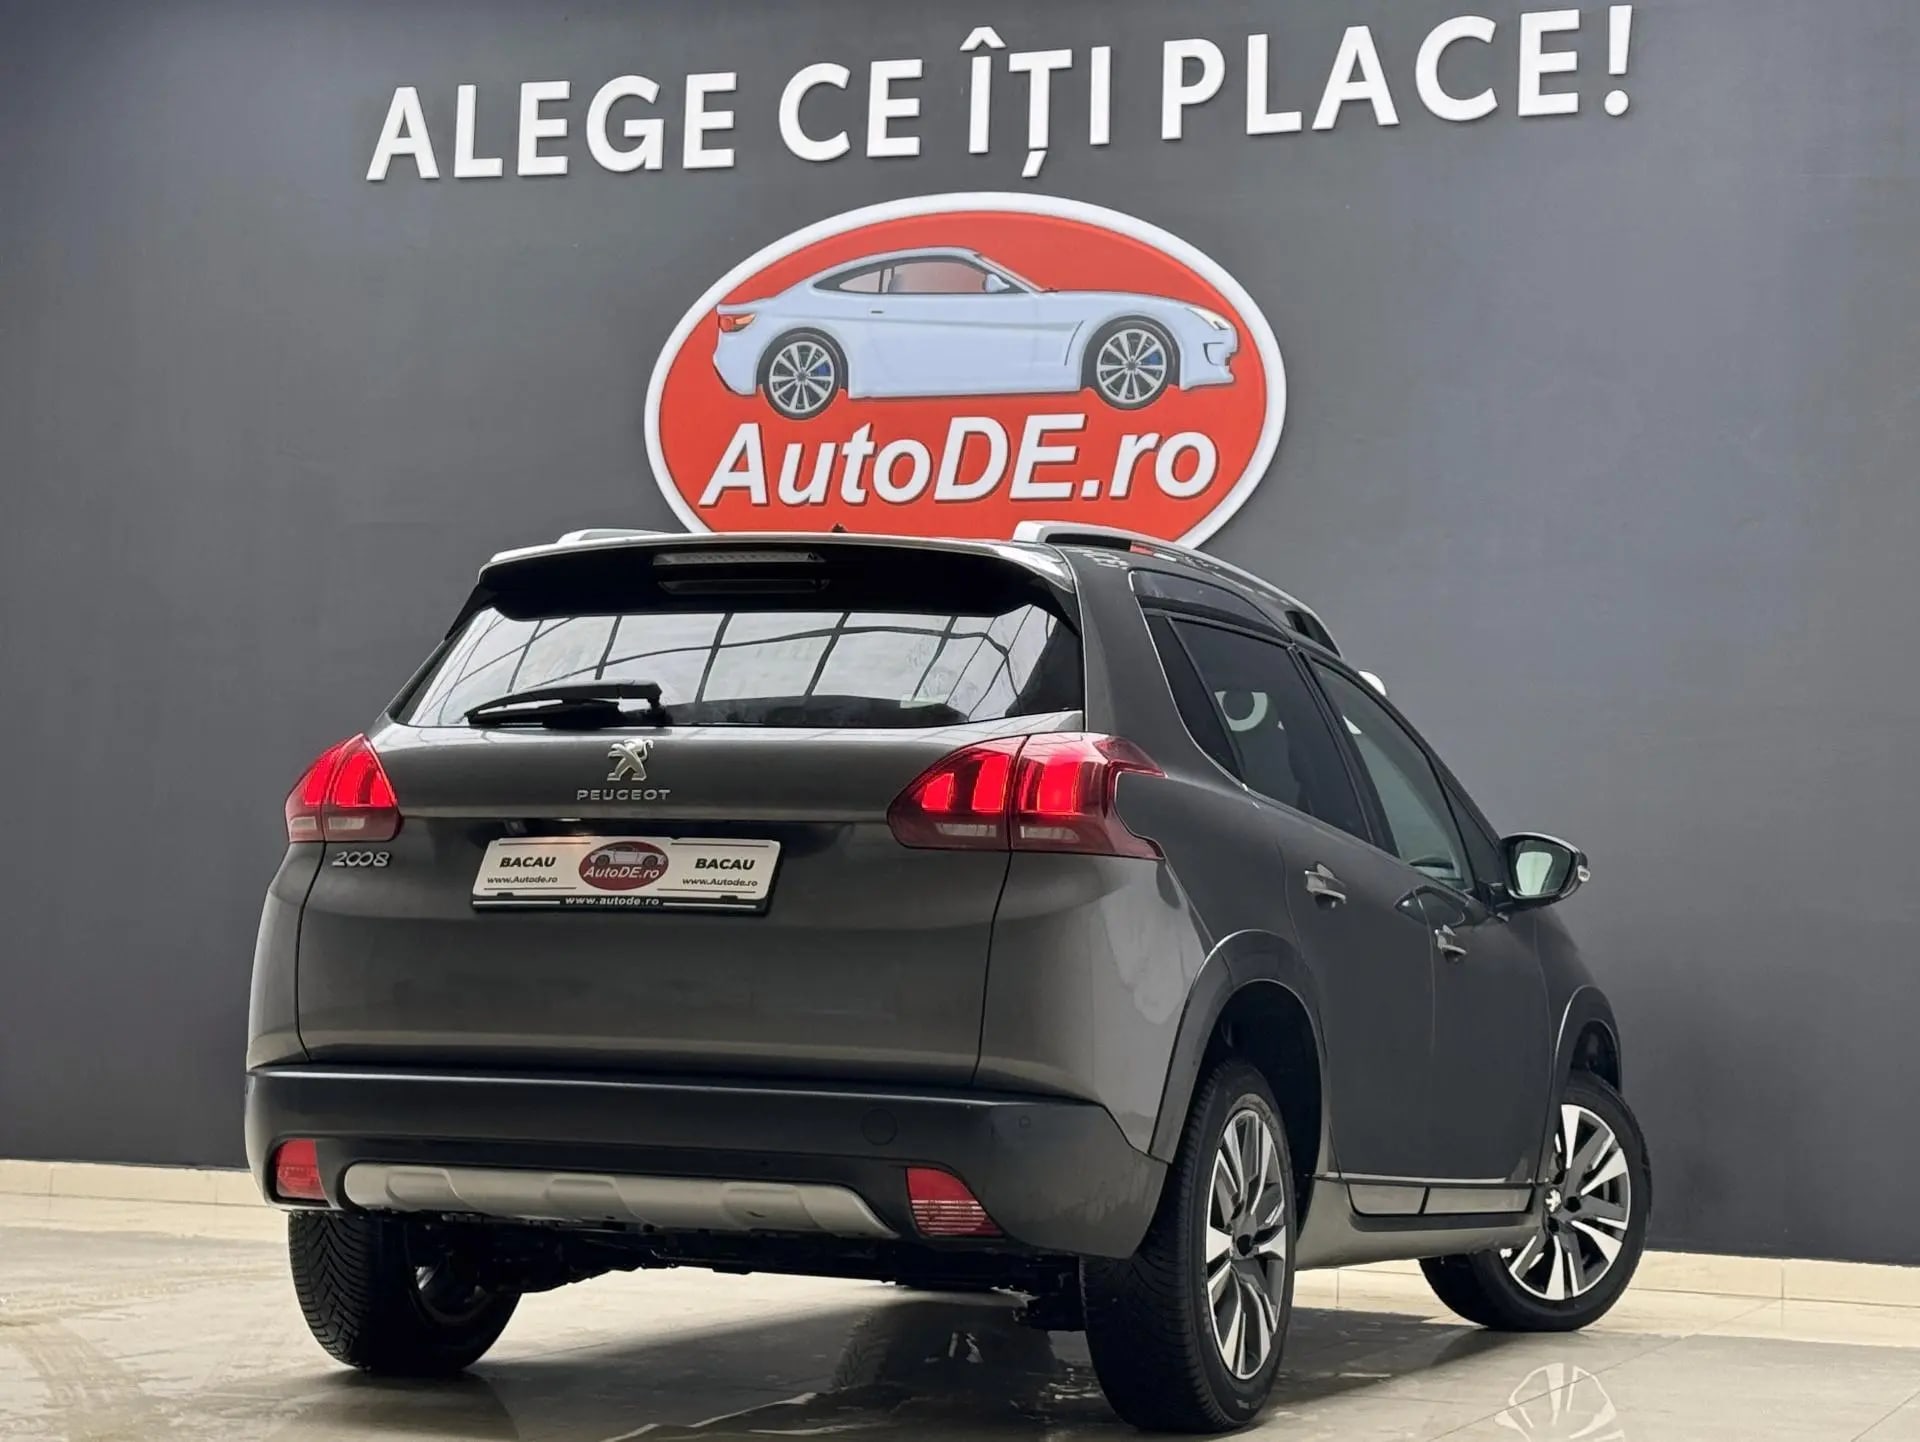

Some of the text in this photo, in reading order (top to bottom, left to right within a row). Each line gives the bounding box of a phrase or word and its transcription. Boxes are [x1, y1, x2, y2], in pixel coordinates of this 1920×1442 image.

[366, 71, 738, 181] ALEGE
[778, 58, 923, 162] CE
[1161, 4, 1634, 141] PLACE!
[698, 413, 1217, 507] AutoDE.ro
[576, 789, 671, 801] PEUGEOT
[331, 850, 391, 868] 2008
[500, 856, 556, 869] BACAU
[695, 857, 756, 871] BACAU
[487, 874, 558, 884] www.Autode.ro
[583, 865, 660, 880] AutoDE.ro
[682, 876, 758, 888] www.Autode.ro
[564, 895, 660, 906] www.autode.ro
